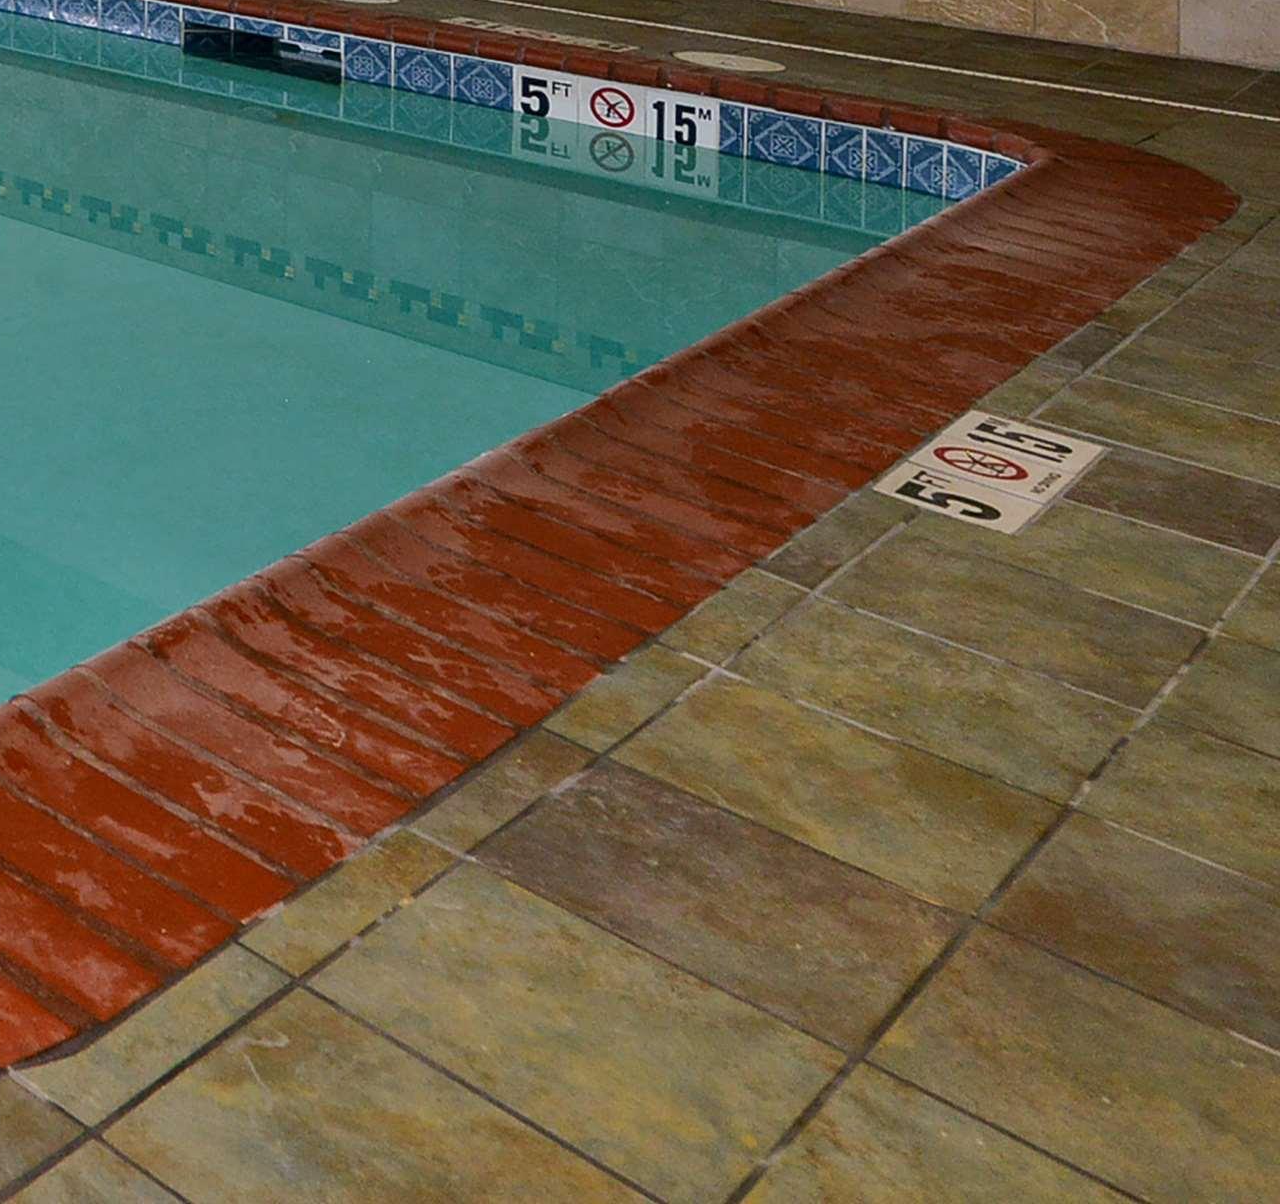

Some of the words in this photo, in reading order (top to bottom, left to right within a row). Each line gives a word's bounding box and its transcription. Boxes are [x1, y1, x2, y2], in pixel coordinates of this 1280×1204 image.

[521, 76, 550, 118] 5
[552, 80, 572, 97] FT
[698, 107, 712, 121] M
[913, 470, 952, 489] FT
[895, 480, 1001, 520] 5
